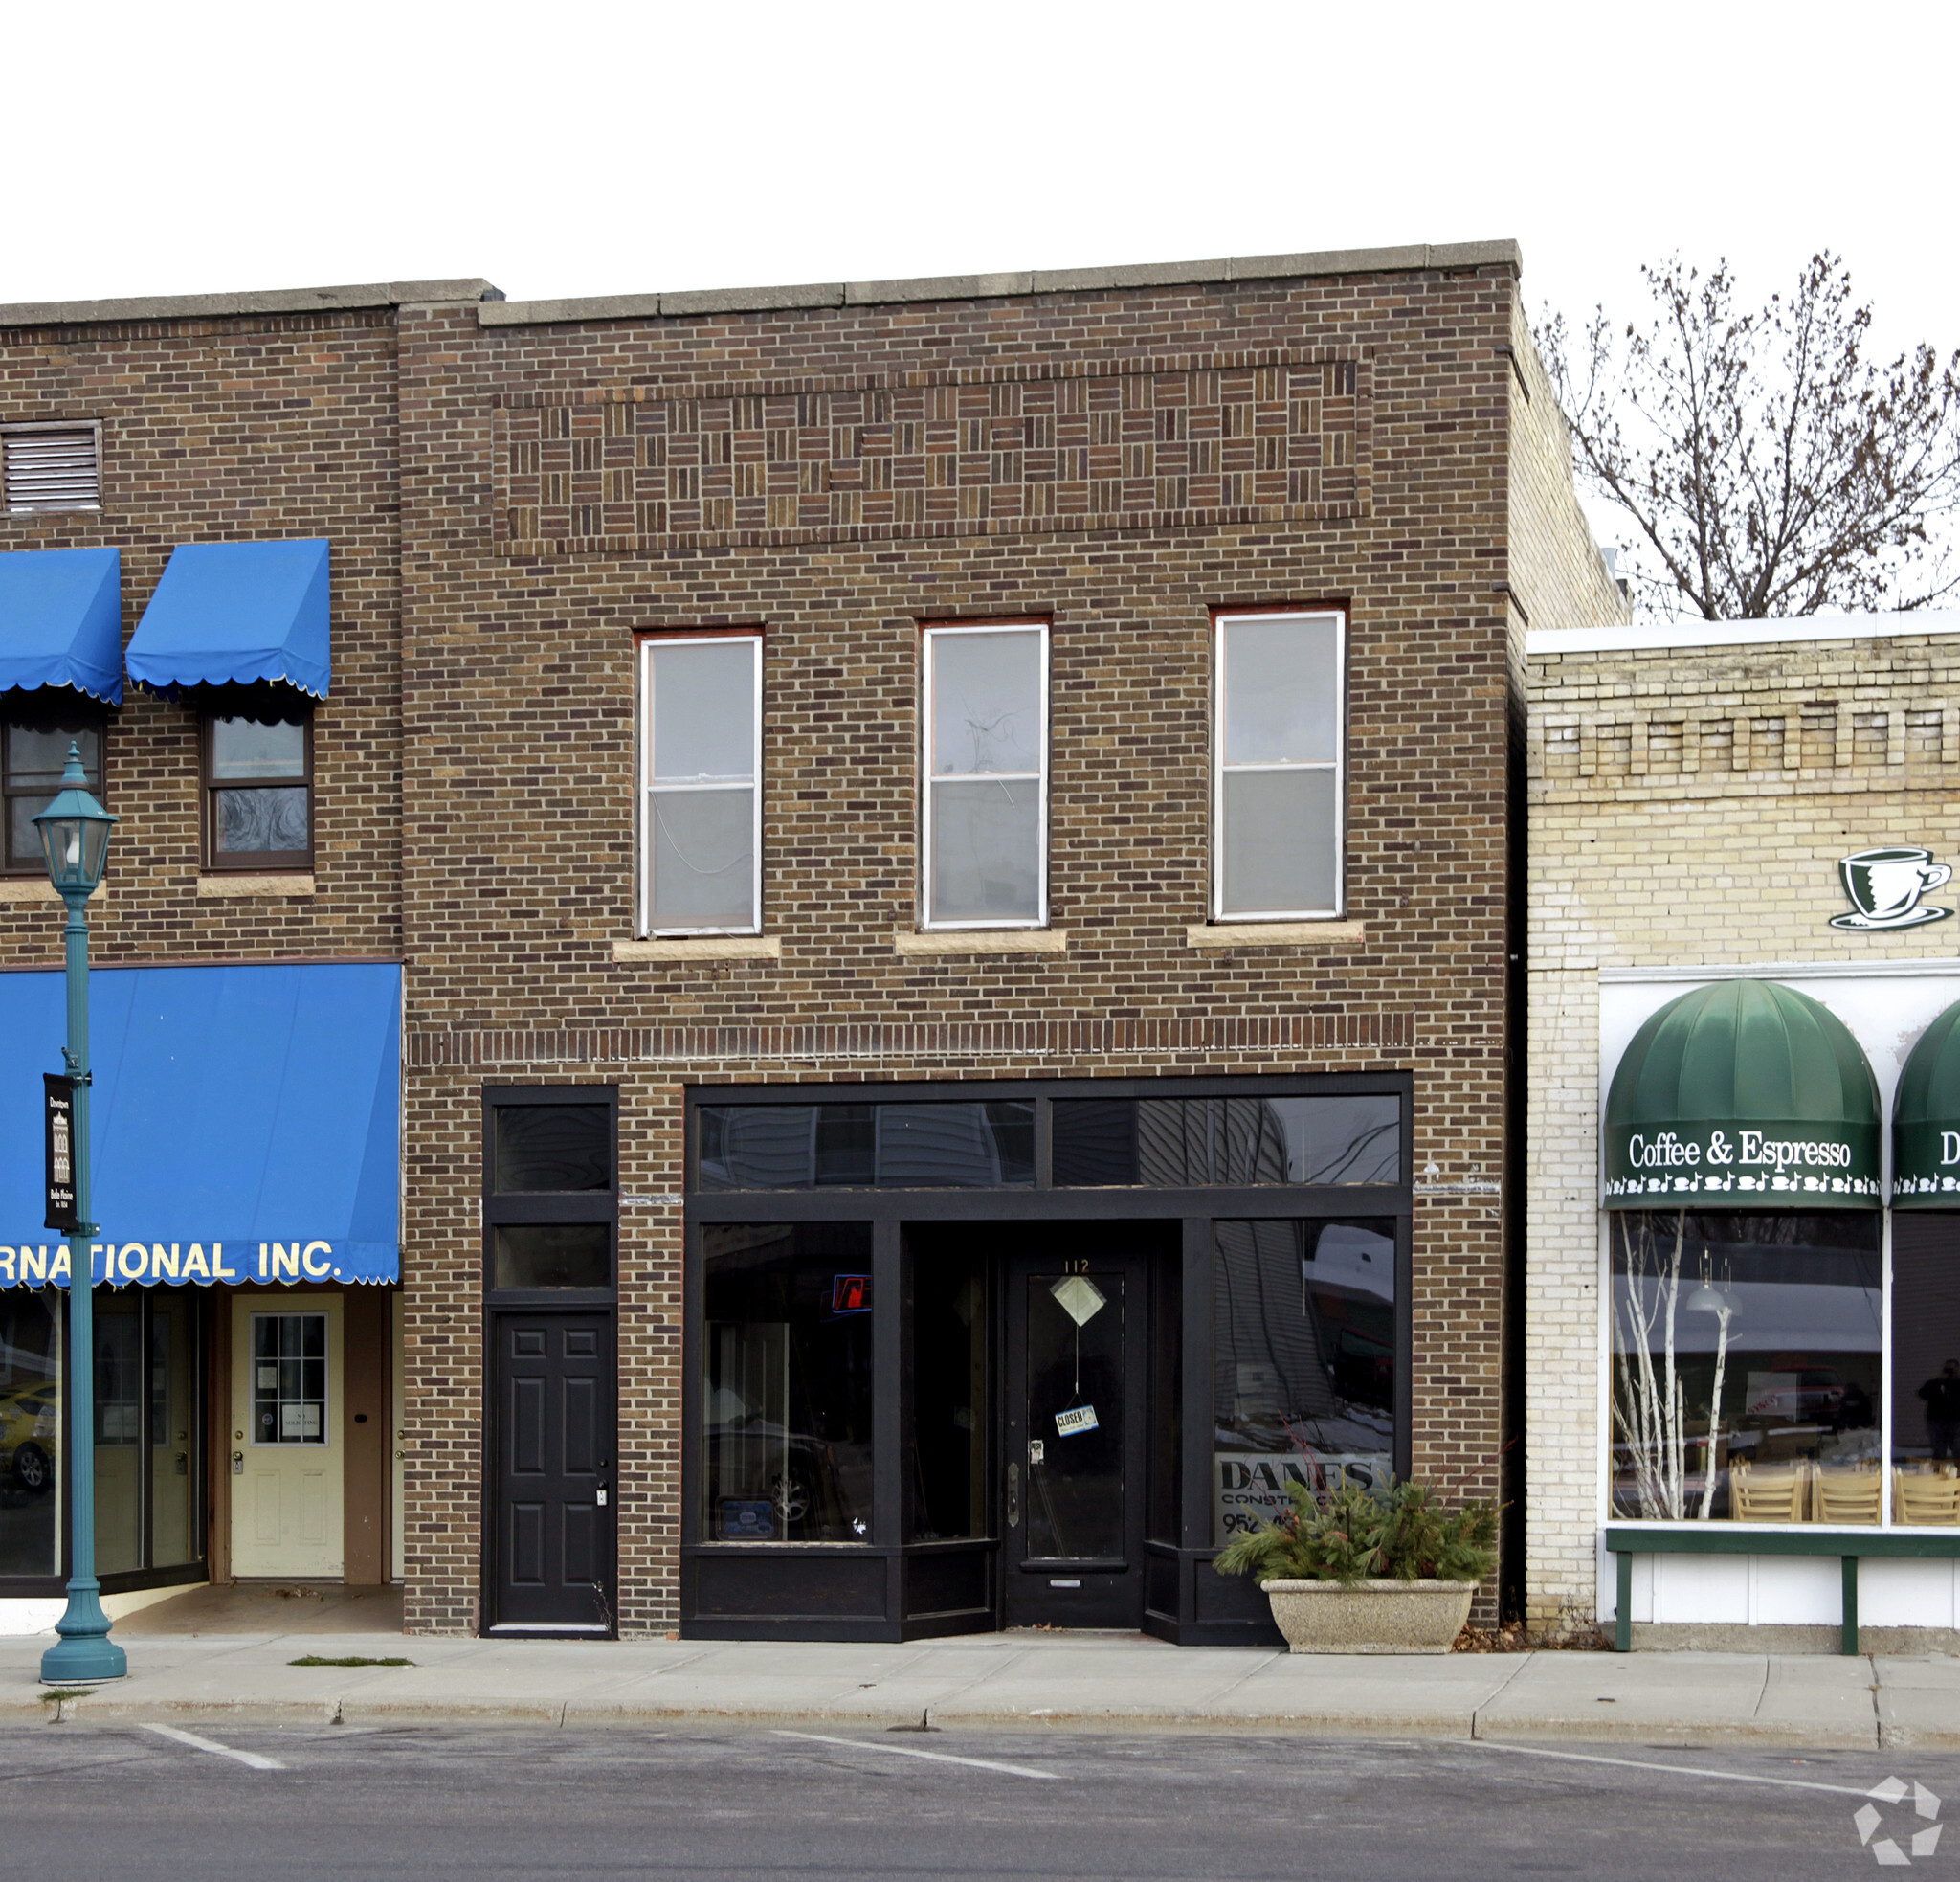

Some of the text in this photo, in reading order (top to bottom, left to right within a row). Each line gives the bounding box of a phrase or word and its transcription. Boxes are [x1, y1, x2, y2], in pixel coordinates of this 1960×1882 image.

[1628, 1130, 1851, 1173] Coffee & Espresso
[257, 1240, 342, 1277] INC.
[1064, 1258, 1090, 1273] 112
[1057, 1410, 1083, 1428] CLOSED
[1219, 1460, 1374, 1491] DANES
